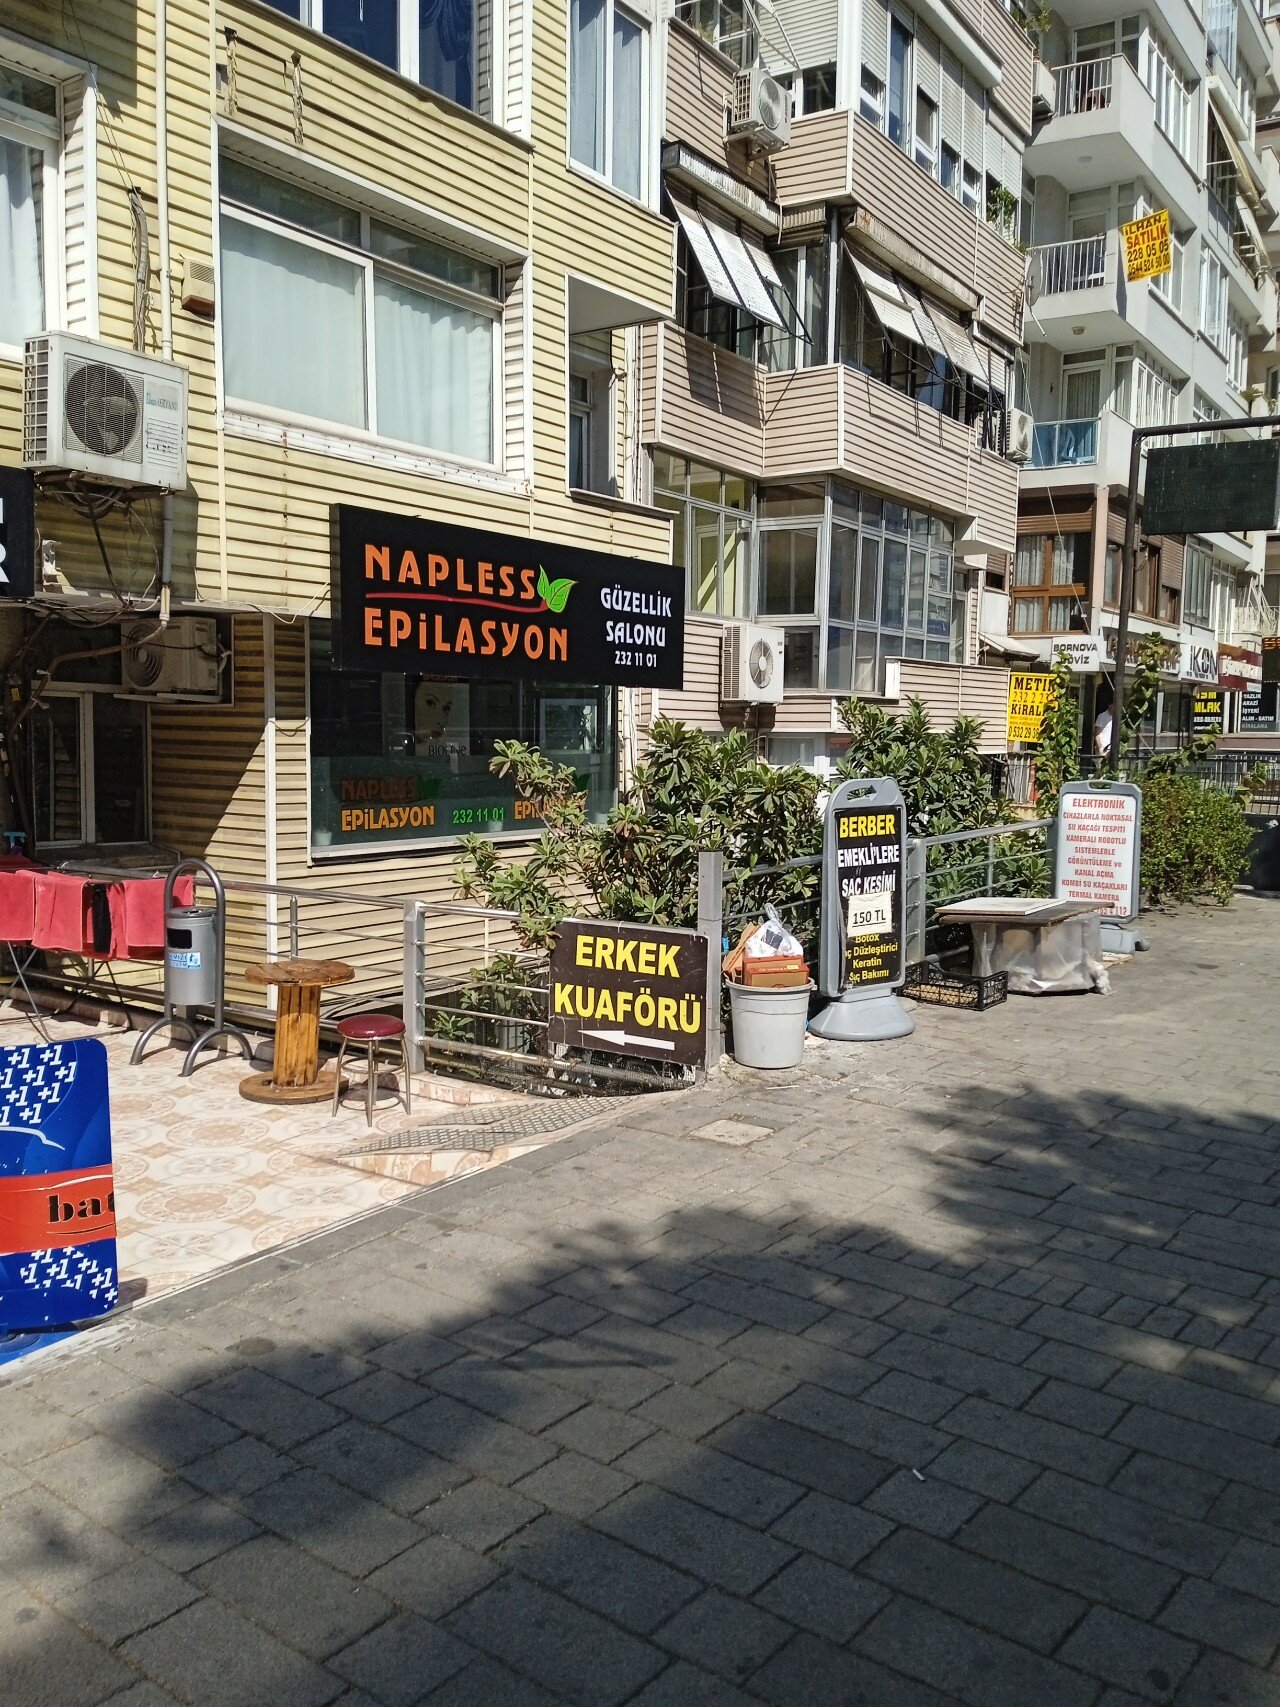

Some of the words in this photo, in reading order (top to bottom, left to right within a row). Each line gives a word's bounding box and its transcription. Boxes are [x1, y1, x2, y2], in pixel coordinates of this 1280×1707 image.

[1127, 223, 1168, 249] SATILIK
[1127, 247, 1143, 263] 228
[1146, 243, 1156, 257] 05
[1159, 239, 1169, 253] 05
[365, 544, 535, 600] NAPLESS
[600, 584, 672, 618] GÜZELLİK
[605, 621, 666, 648] SALONU
[1053, 643, 1098, 652] BORNOVA
[614, 650, 631, 666] 232
[635, 651, 643, 667] 11
[646, 652, 657, 668] 01
[1013, 726, 1023, 738] 532
[1072, 797, 1125, 809] ELEKTRONİK
[453, 809, 473, 825] 232
[477, 808, 488, 822] 11
[493, 807, 505, 822] 01
[1101, 814, 1133, 822] NOKTASAL
[839, 814, 896, 839] BERBER
[1066, 834, 1097, 844] KAMERALI
[1098, 836, 1126, 845] ROBOTLU
[1067, 856, 1112, 867] GÖRÜNTÜLEME
[1074, 868, 1094, 877] KANAL
[1096, 870, 1114, 880] AÇMA
[863, 870, 896, 895] KESİMİ
[1083, 880, 1092, 888] SU
[1093, 882, 1127, 892] KAÇAKLARI
[1069, 890, 1092, 899] TERMAL
[1094, 892, 1119, 902] KAMERA
[853, 911, 872, 925] 150
[876, 909, 886, 922] TL
[855, 933, 880, 944] Botox
[853, 942, 898, 956] Düzleştirici
[576, 935, 682, 978] ERKEK
[853, 957, 882, 969] Keratin
[862, 969, 889, 980] Bakımı
[554, 982, 701, 1034] KUAFÖRÜ
